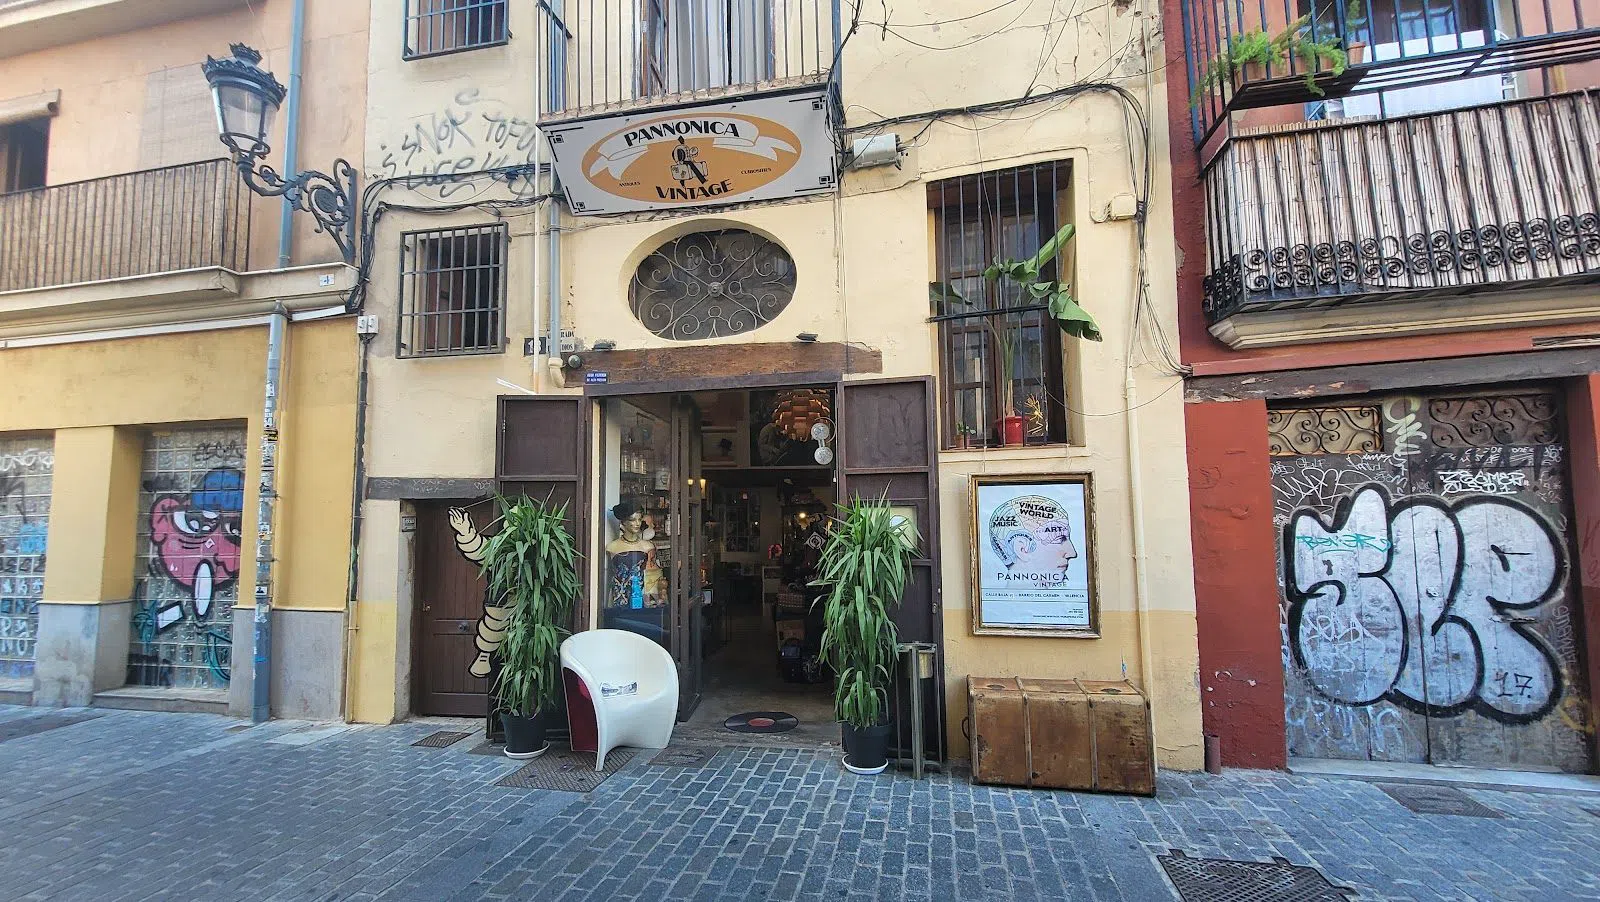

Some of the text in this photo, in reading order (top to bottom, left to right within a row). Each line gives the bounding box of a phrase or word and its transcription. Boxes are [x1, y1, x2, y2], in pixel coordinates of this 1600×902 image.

[623, 119, 740, 148] PANNONICA
[655, 178, 735, 200] VINTAGE
[1018, 501, 1058, 514] VINTAGE
[1019, 508, 1055, 520] WORLD
[997, 572, 1070, 582] PANNONICA
